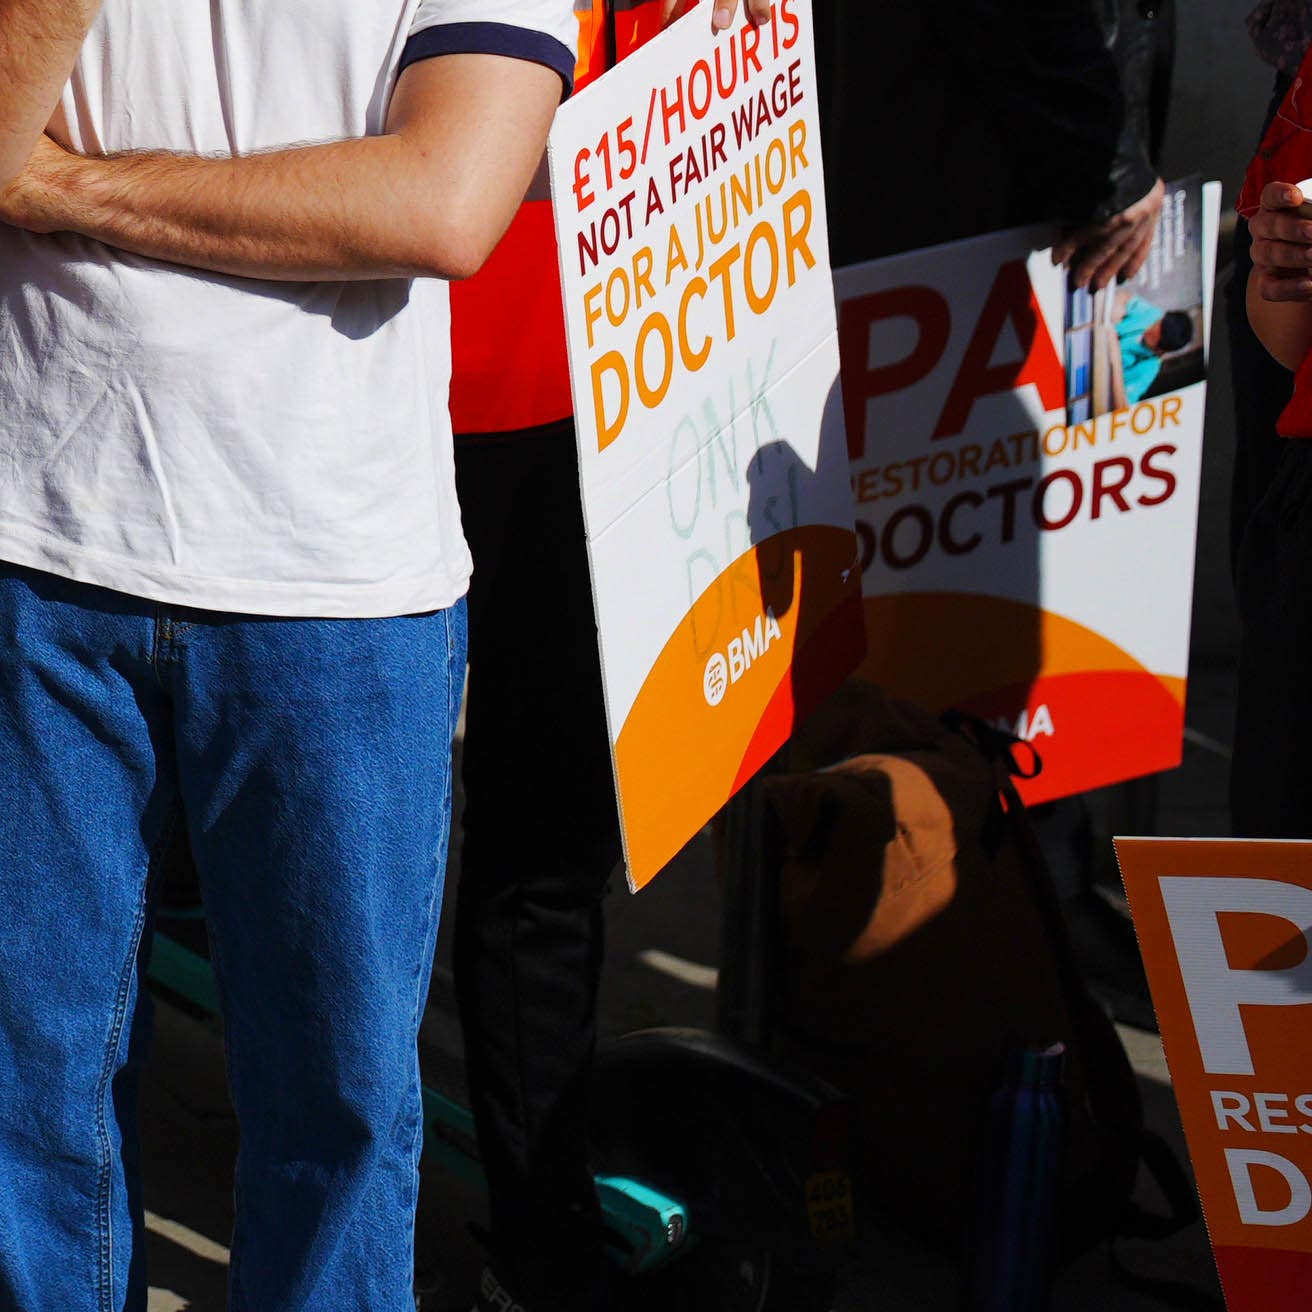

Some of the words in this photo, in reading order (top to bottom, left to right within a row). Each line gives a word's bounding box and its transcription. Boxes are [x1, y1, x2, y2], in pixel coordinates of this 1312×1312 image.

[572, 24, 761, 213] £15/HOUR
[577, 190, 636, 276] NOT
[645, 176, 664, 227] A
[670, 128, 727, 206] FAIR
[731, 58, 804, 151] WAGE
[583, 245, 656, 349] FOR
[665, 224, 688, 286] A
[695, 118, 809, 270] JUNIOR
[590, 188, 817, 453] DOCTOR
[839, 258, 1066, 462] PA
[850, 420, 1097, 504] ESTORATION
[1110, 396, 1182, 441] FOR
[726, 606, 782, 685] BMA
